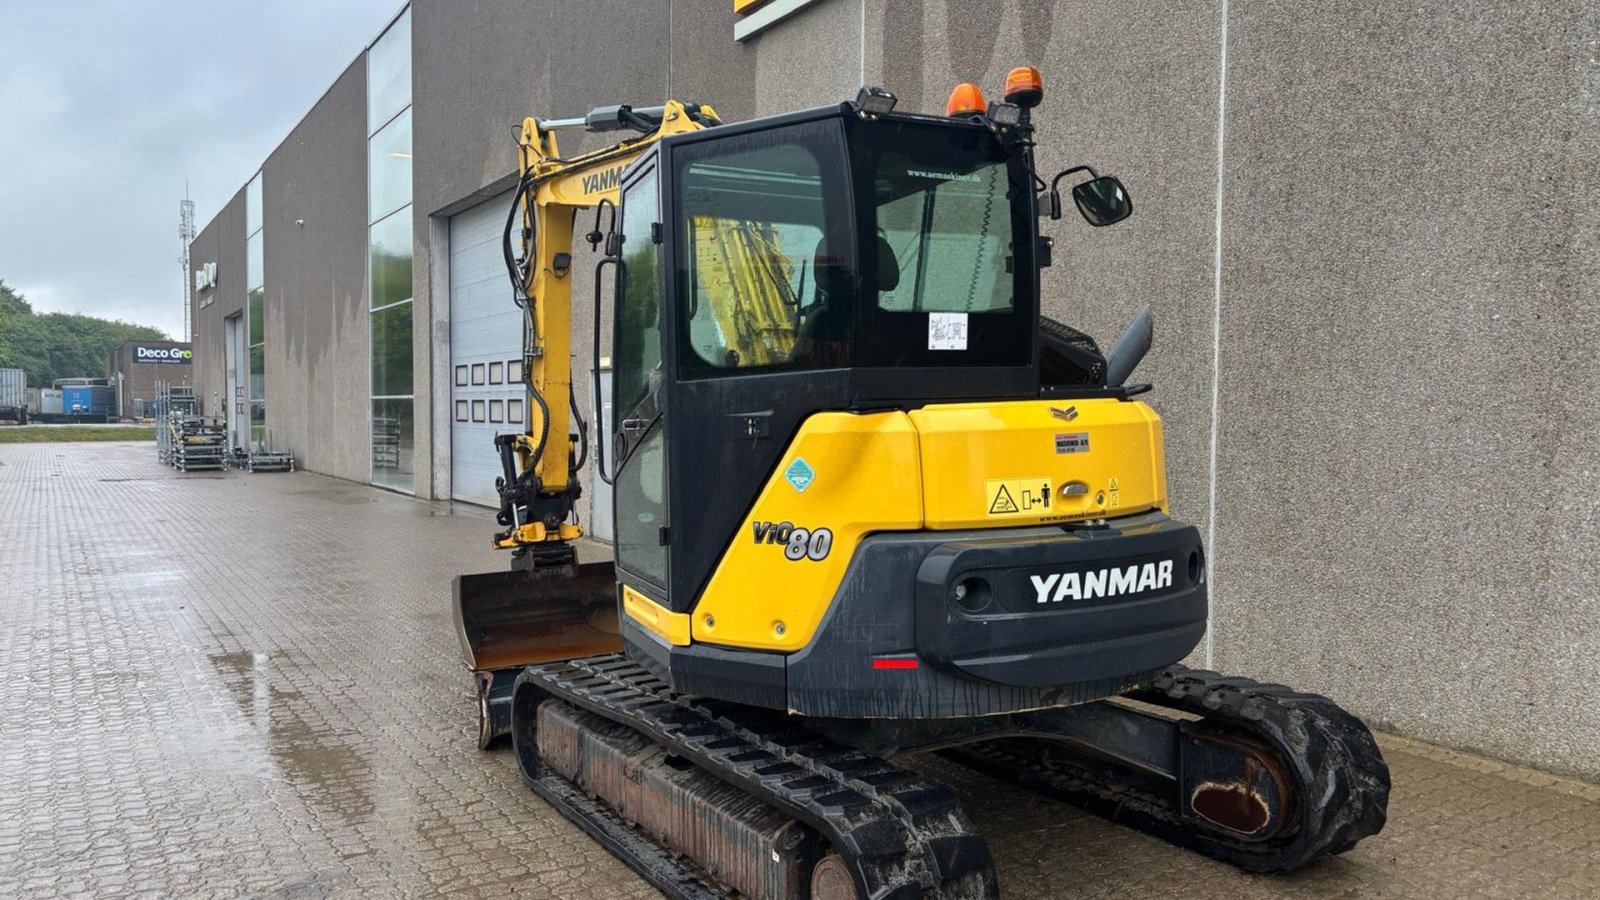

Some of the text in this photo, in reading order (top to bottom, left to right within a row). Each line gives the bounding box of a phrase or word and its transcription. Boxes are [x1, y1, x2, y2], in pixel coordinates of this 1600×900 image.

[582, 163, 631, 195] YANM
[137, 347, 168, 358] Deco
[1030, 559, 1173, 603] YANMAR
